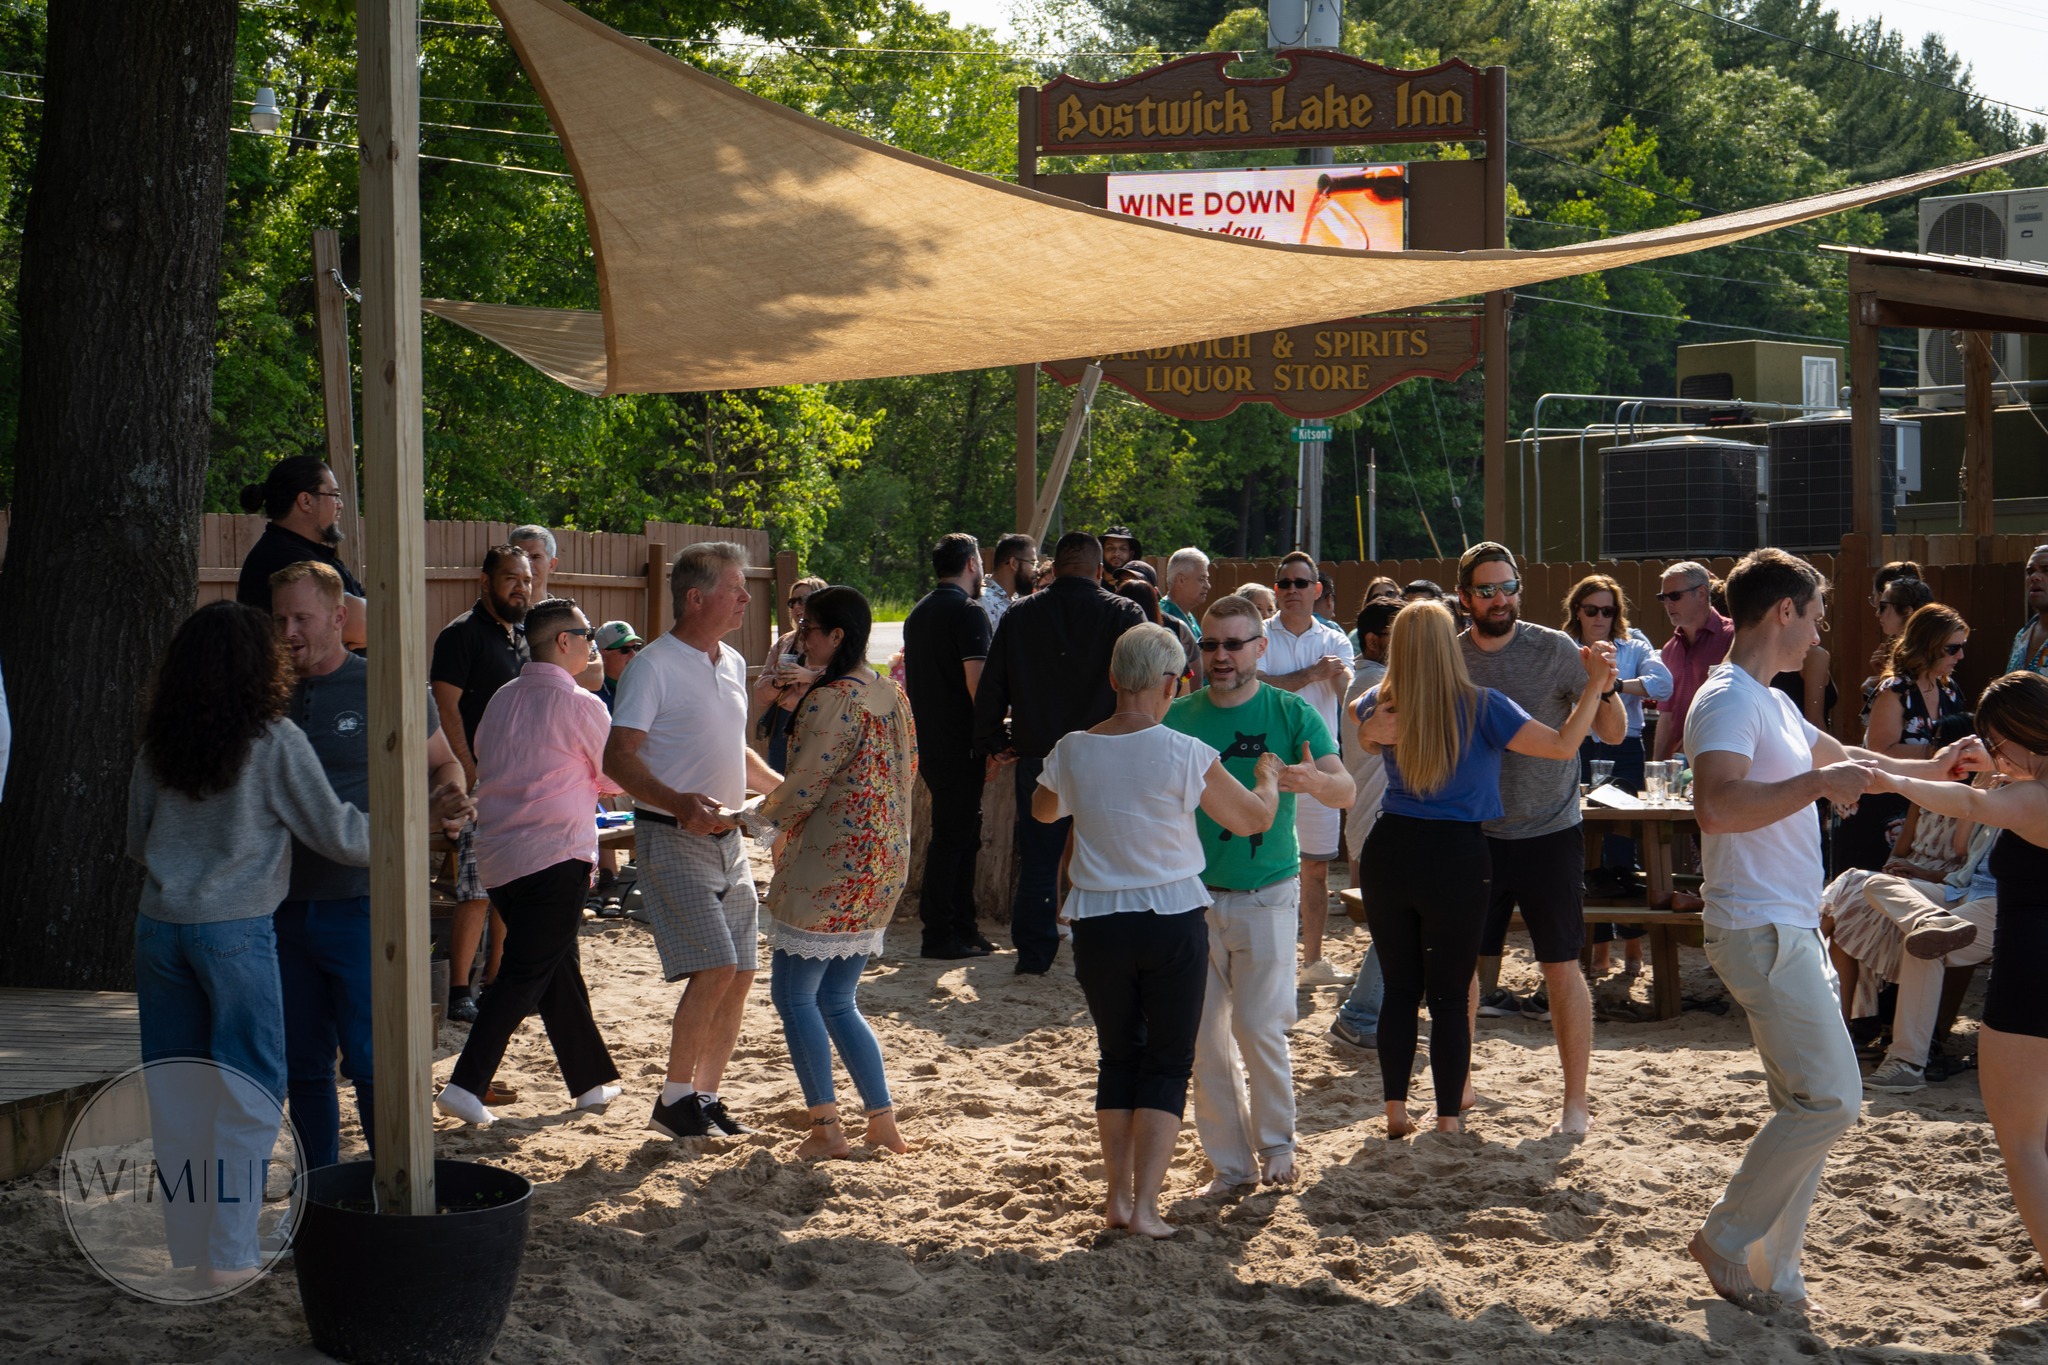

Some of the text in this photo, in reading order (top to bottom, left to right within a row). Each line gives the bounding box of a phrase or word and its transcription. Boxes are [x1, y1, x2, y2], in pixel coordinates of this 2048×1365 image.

[1057, 80, 1463, 142] Bostwick Lake Inn
[1118, 189, 1295, 217] WINE DOWN
[1272, 331, 1295, 359] &
[1314, 329, 1429, 358] SPIRITS
[1144, 363, 1370, 396] LIQUOR STORE
[1298, 428, 1327, 440] Kitson
